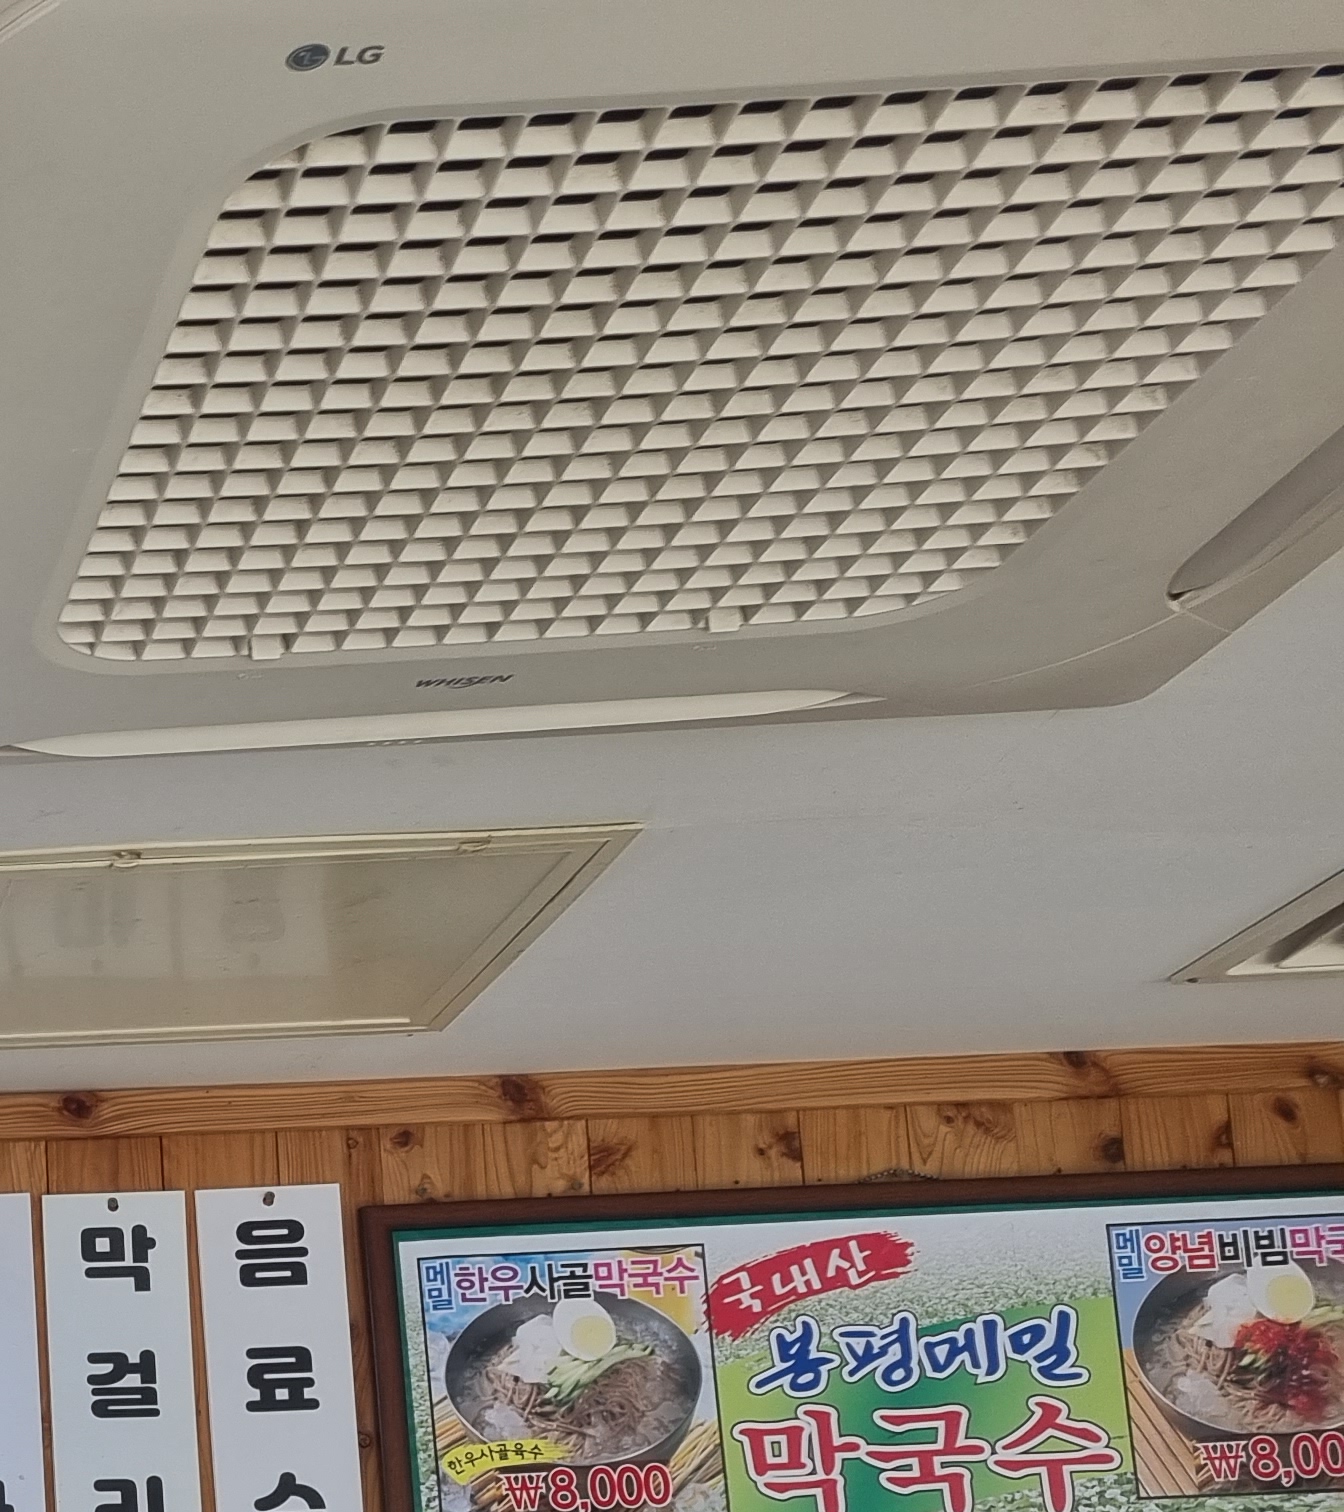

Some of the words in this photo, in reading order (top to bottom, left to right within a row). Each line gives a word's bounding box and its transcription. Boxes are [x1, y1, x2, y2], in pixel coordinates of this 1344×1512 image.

[333, 45, 385, 66] LG
[415, 674, 515, 689] WHISEN
[454, 1254, 701, 1305] 한우사골막국수
[722, 1240, 873, 1312] 국내산
[1113, 1227, 1146, 1282] 메밀
[424, 1261, 454, 1312] 메밀
[750, 1306, 1088, 1396] 봉평메밀
[448, 1442, 545, 1475] 한우사골육수
